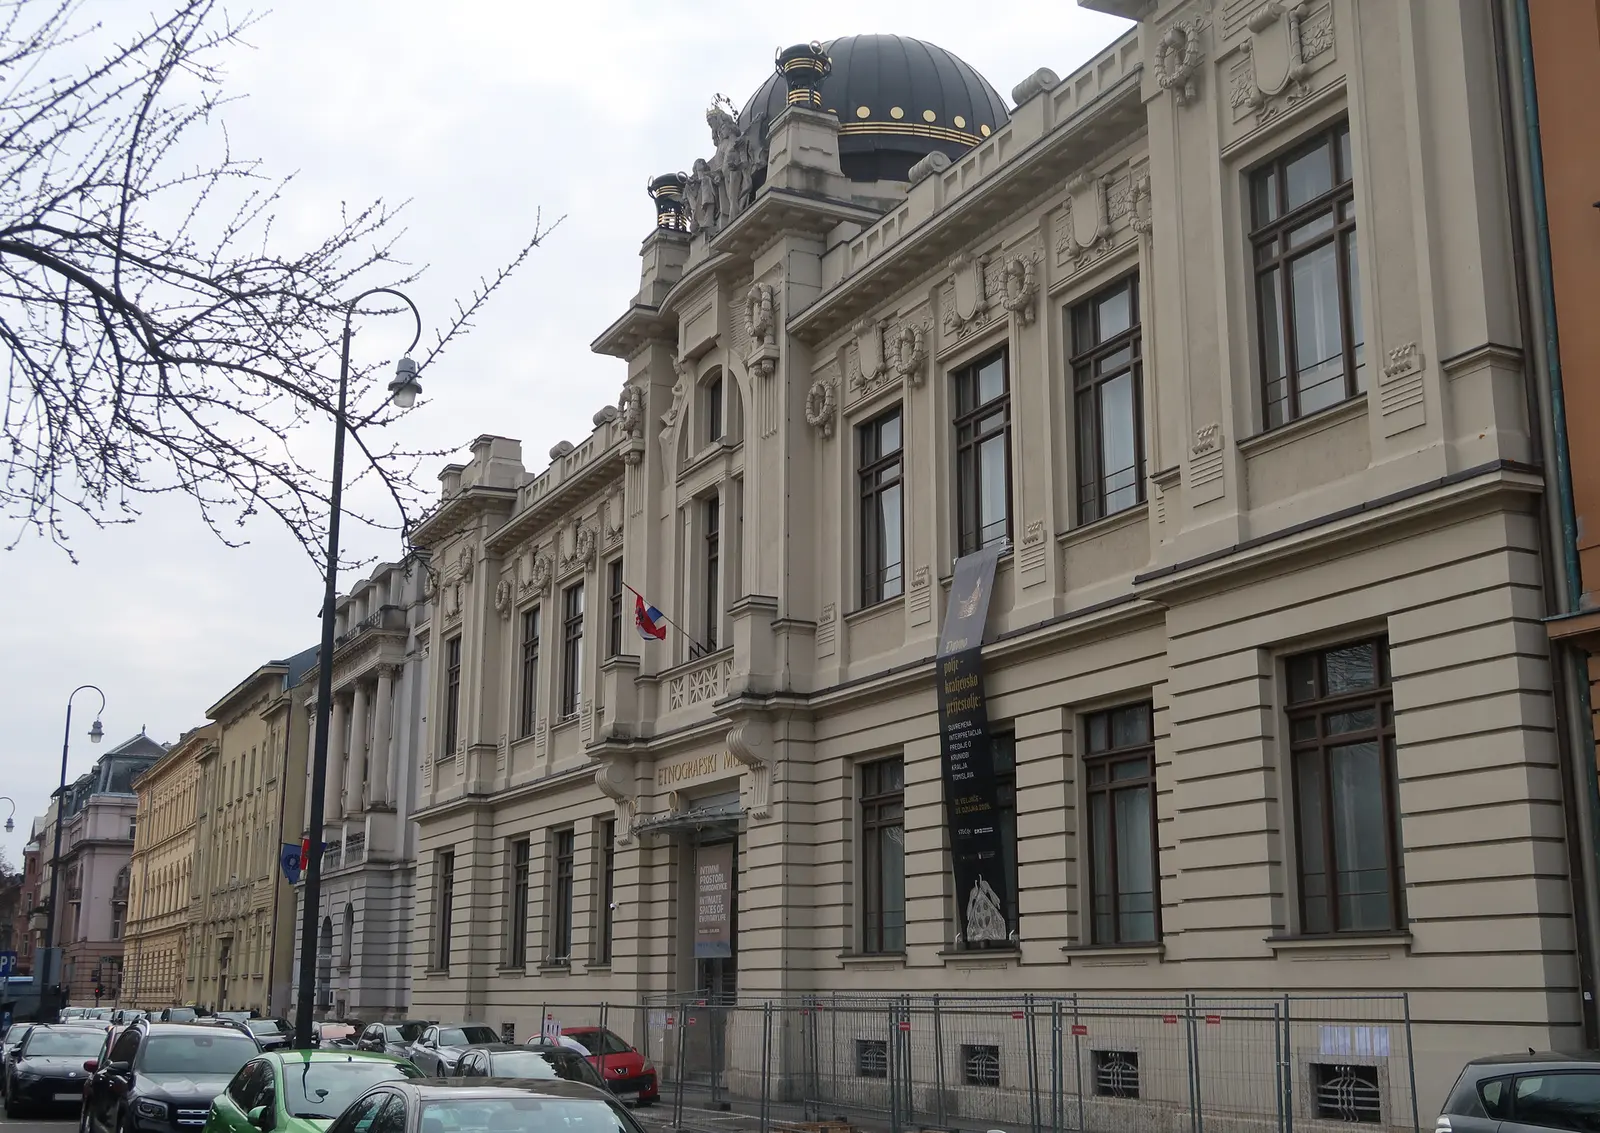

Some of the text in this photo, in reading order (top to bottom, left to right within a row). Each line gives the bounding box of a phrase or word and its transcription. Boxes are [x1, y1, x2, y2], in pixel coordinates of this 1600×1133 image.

[944, 657, 959, 676] polje
[948, 720, 972, 731] SUVREMENA
[949, 728, 982, 741] INTERPRETACIJA
[658, 753, 717, 786] ETNOGRAFSKI
[699, 894, 722, 905] INTIMATE
[699, 904, 724, 915] SPACES OF
[0, 956, 8, 972] P
[9, 956, 16, 972] P
